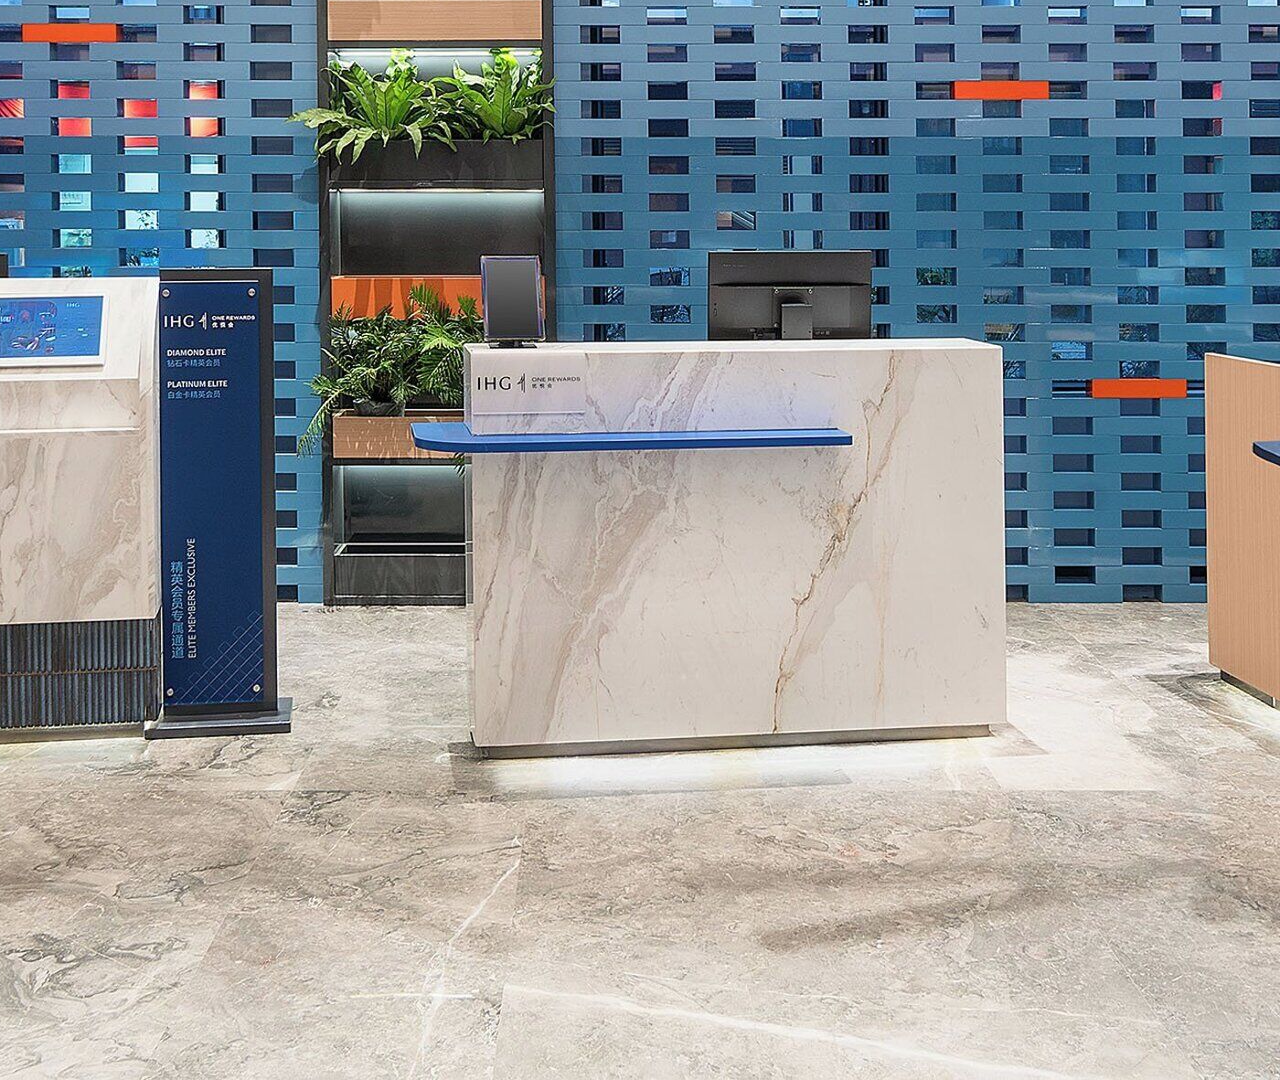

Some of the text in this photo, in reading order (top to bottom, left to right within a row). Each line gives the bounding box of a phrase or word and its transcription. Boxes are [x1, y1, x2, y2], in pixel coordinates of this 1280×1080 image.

[164, 315, 195, 328] IHG
[167, 348, 227, 357] DIAMOND ELITE
[167, 359, 220, 367] 钻石卡精英会员
[167, 380, 228, 389] PLATINUM ELITE
[477, 376, 512, 391] IHG
[167, 390, 220, 399] 白金卡精英会员
[186, 537, 197, 659] ELITE MEMBERS EXCLUSIVE
[171, 561, 184, 659] 精英会员专属通道
